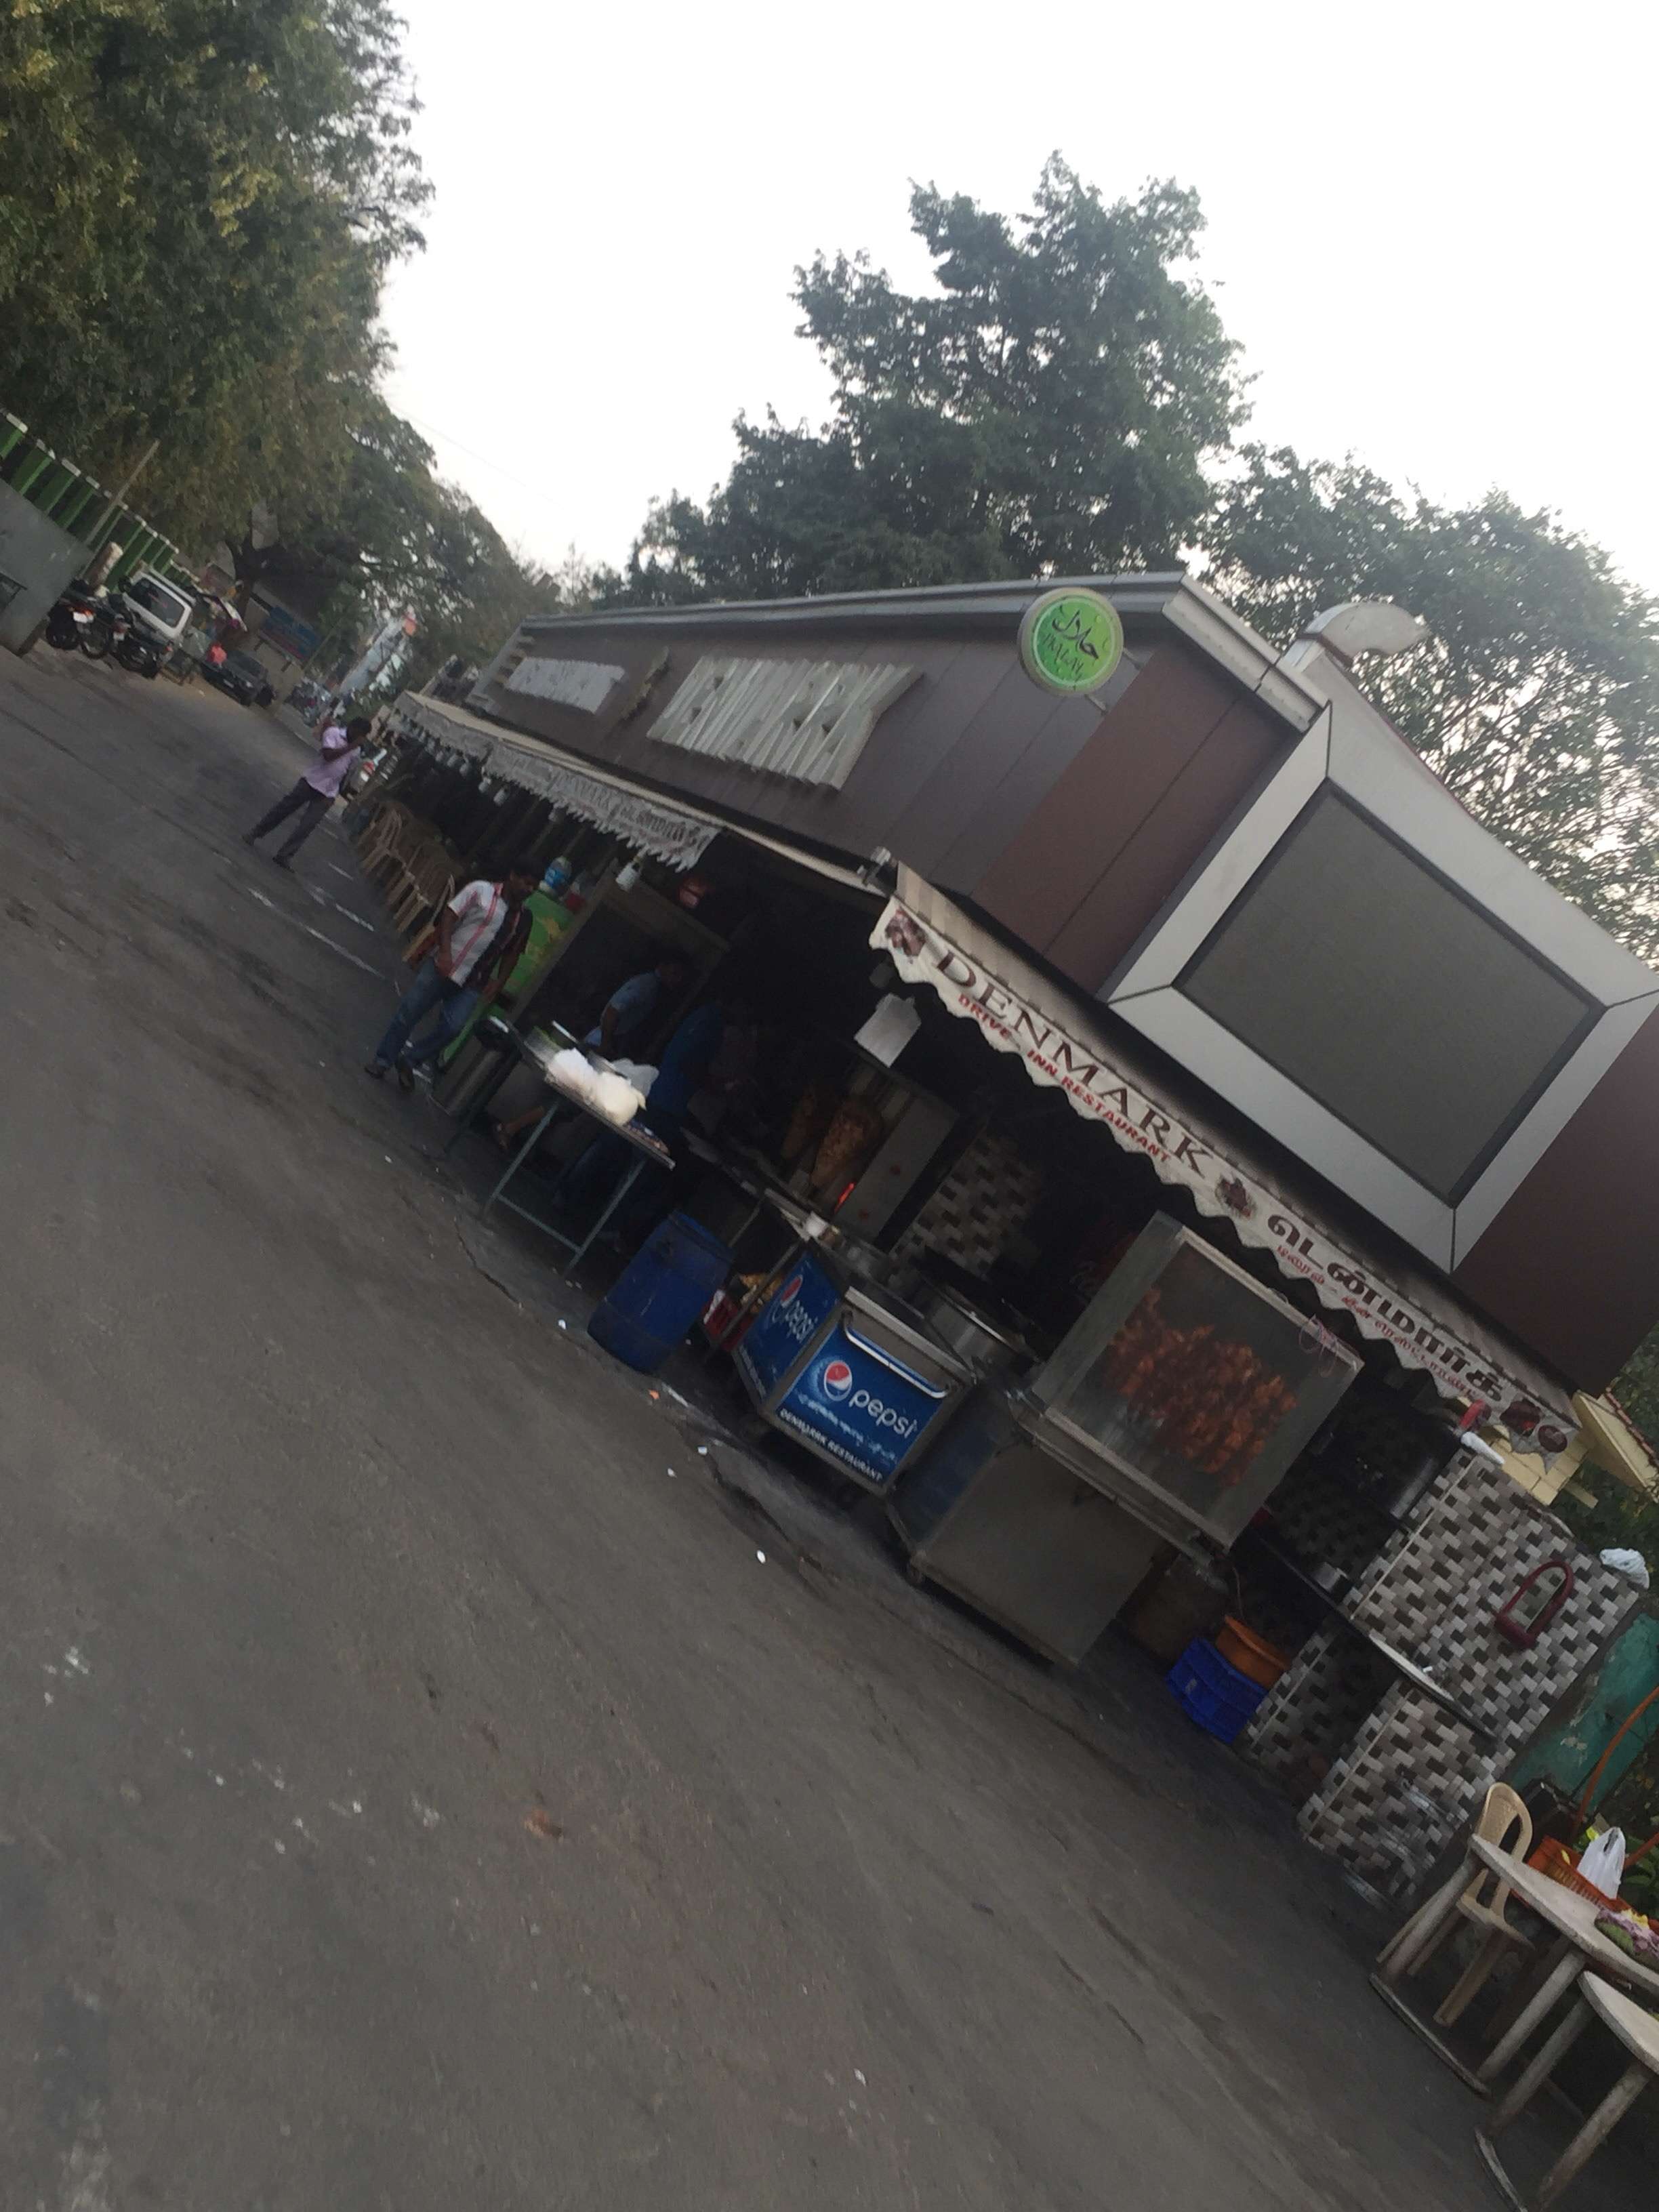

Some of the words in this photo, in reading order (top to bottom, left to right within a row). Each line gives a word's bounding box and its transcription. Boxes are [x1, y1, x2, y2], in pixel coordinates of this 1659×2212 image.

[936, 951, 1214, 1179] DENMARK
[958, 994, 1010, 1039] DRIVE
[1026, 1050, 1058, 1078] INN
[1061, 1075, 1172, 1163] RESTAURANT
[1267, 1214, 1502, 1402] டென்மார்க்
[827, 1439, 883, 1481] RESTAURANT
[848, 1389, 918, 1439] pepsi
